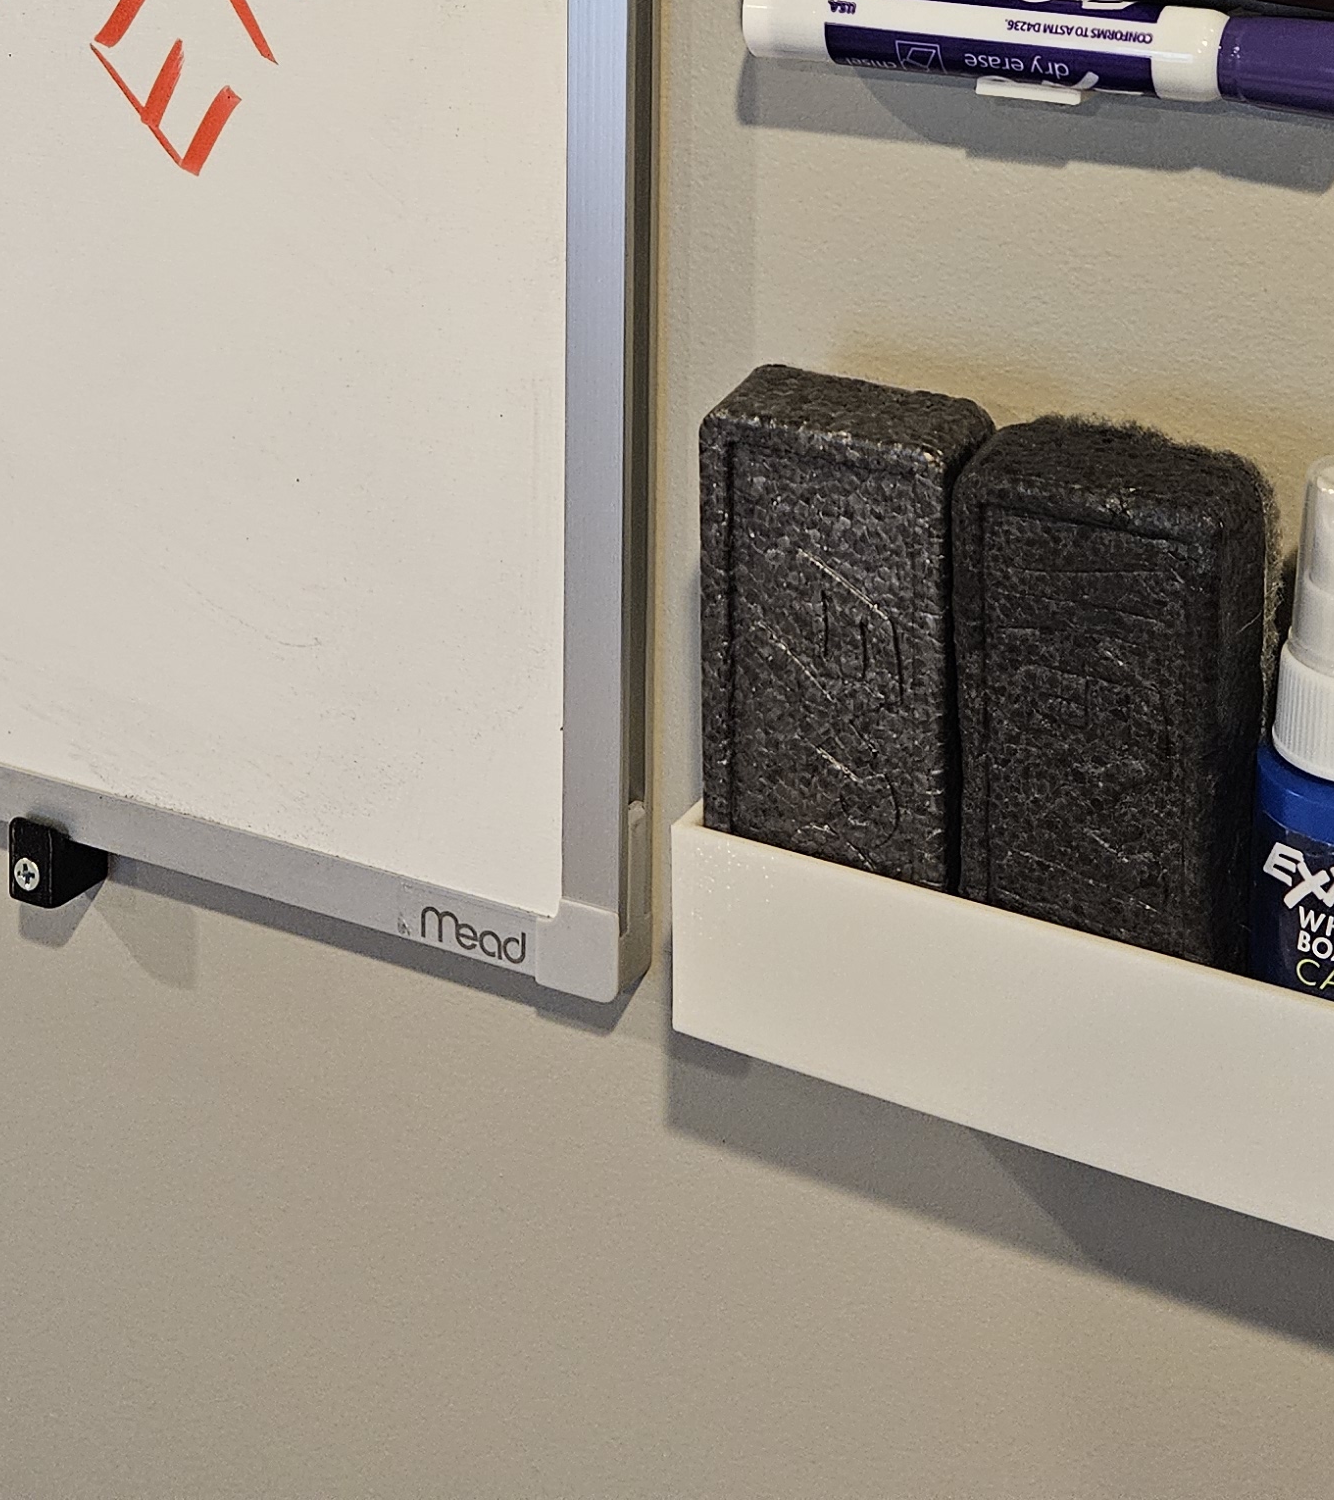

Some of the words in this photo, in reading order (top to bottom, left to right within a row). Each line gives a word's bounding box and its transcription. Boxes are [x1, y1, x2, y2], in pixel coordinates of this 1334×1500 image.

[1004, 19, 1041, 33] D4236.
[1042, 23, 1074, 37] ASTM
[1075, 26, 1089, 38] TO
[1090, 27, 1153, 44] CONFORMS
[963, 53, 1024, 74] erase
[1030, 57, 1070, 79] dry
